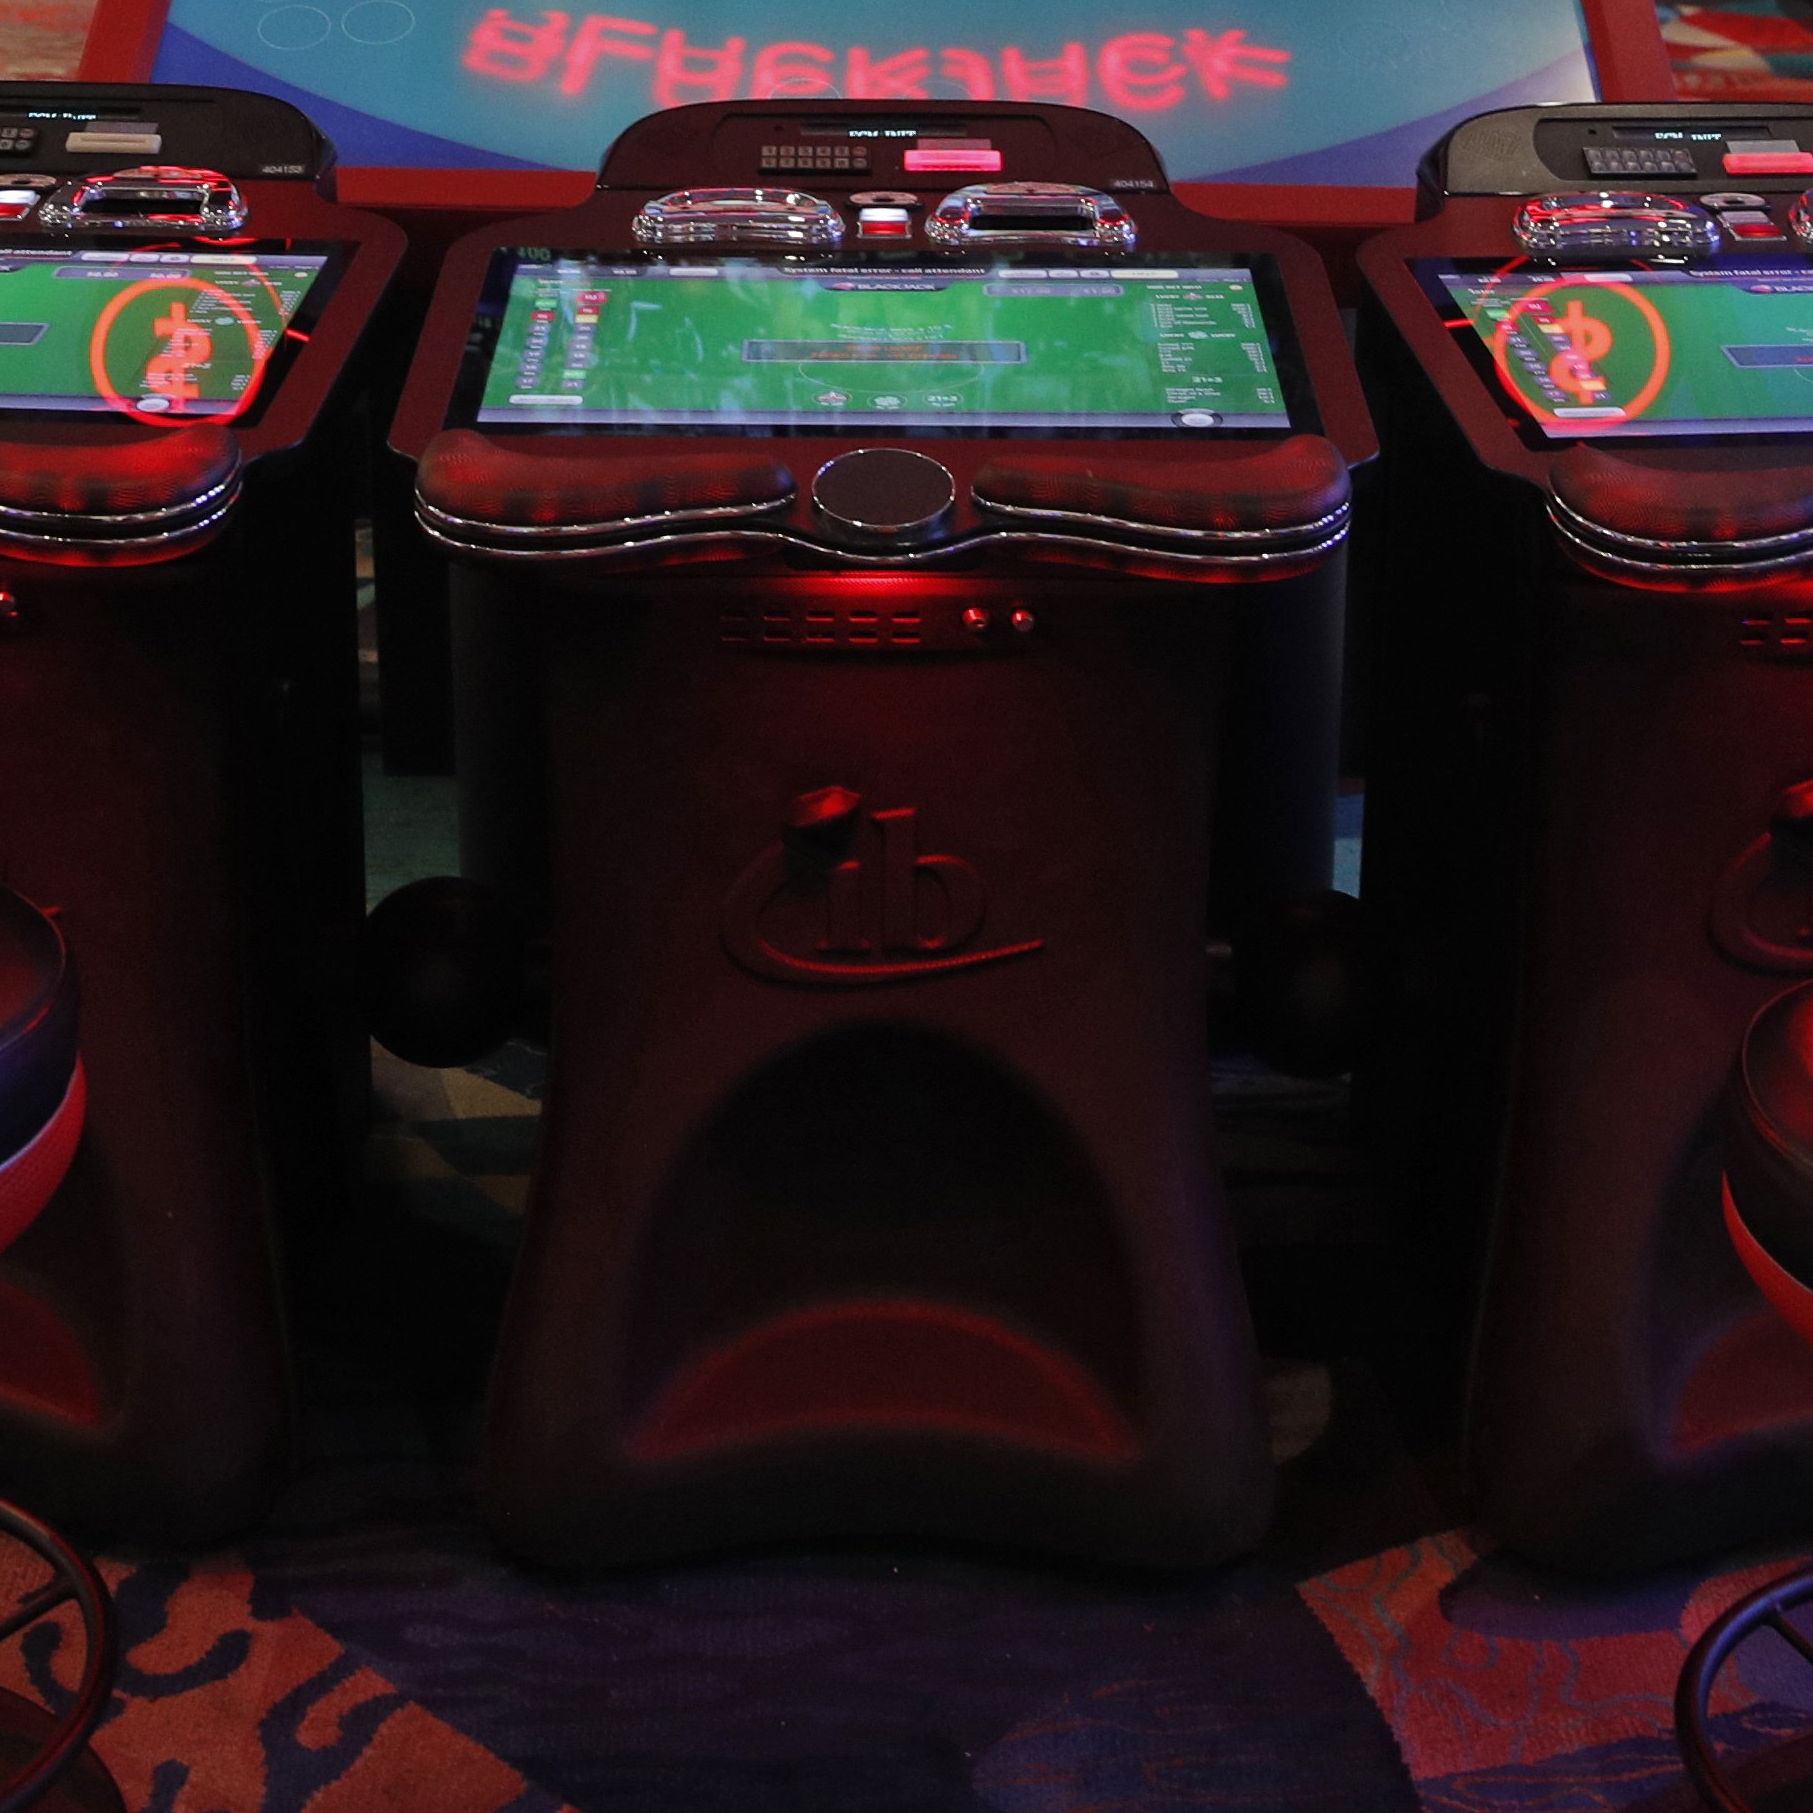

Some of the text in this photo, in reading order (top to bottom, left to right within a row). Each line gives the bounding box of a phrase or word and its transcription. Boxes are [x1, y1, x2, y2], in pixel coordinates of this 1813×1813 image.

[783, 267, 829, 276] System
[830, 267, 860, 275] fatal
[861, 267, 893, 275] error
[901, 267, 924, 275] call
[925, 267, 986, 275] attendant
[1689, 269, 1732, 278] System
[1734, 268, 1761, 277] fatal
[856, 283, 937, 291] BLACKJACK
